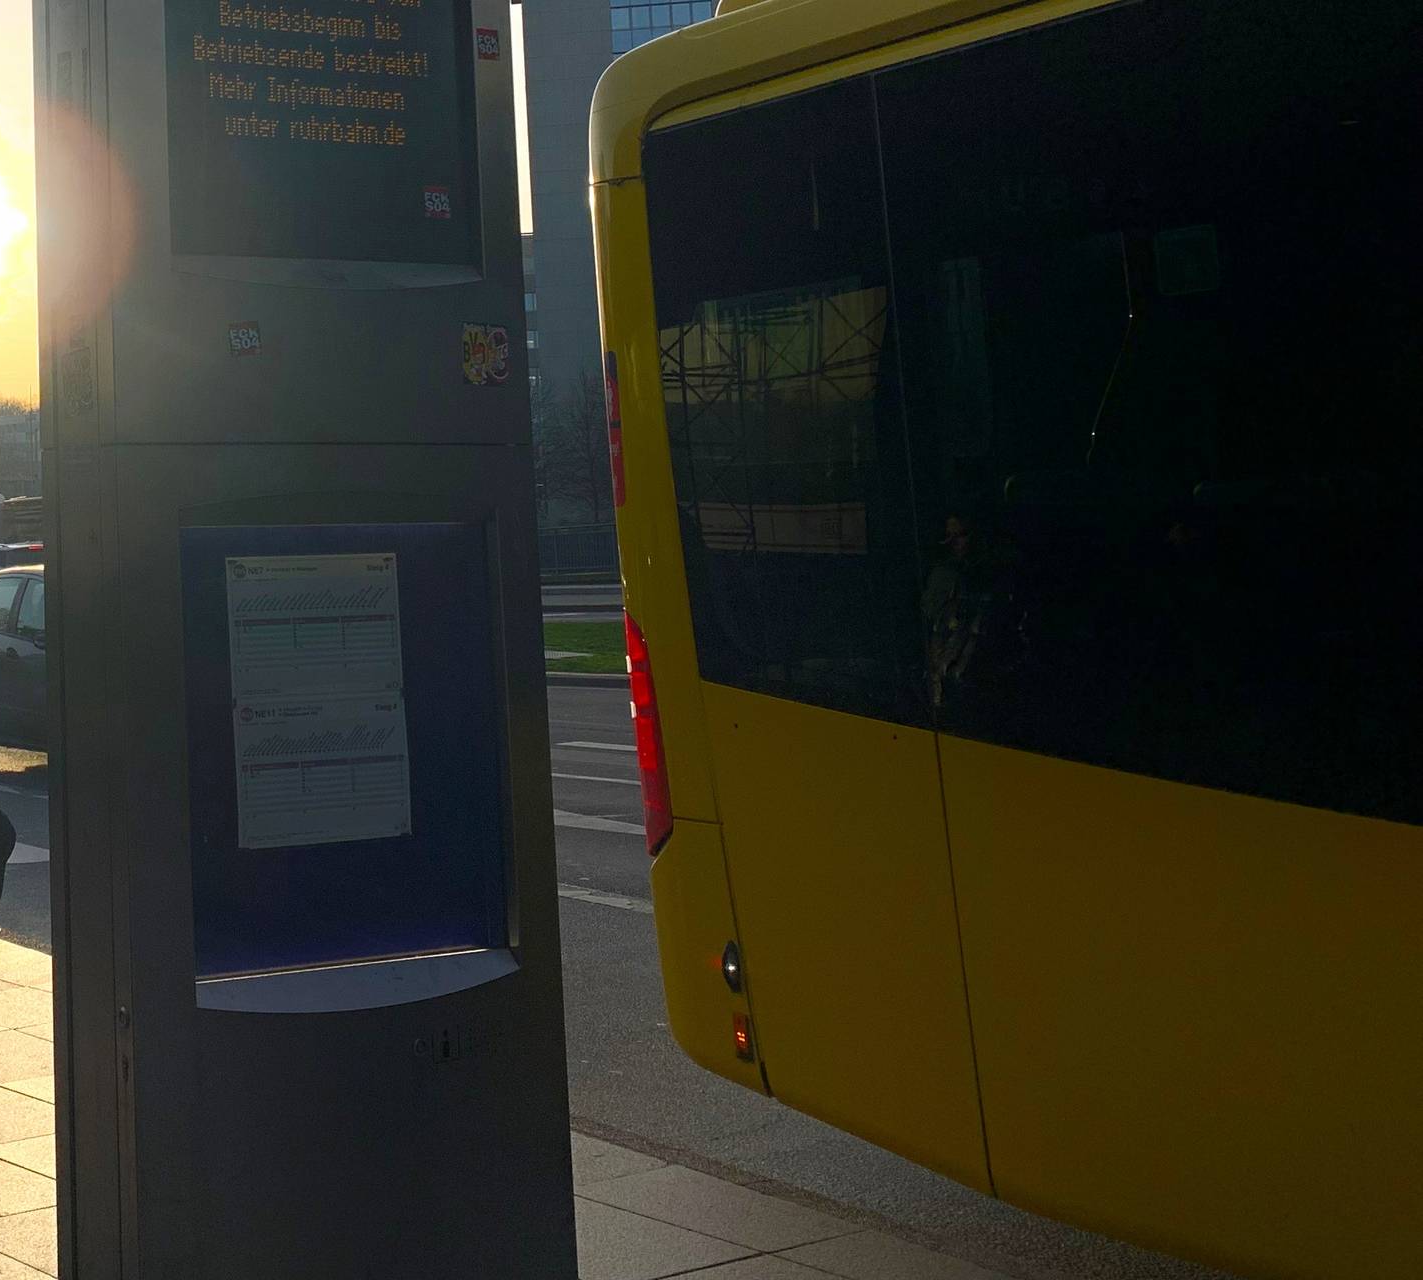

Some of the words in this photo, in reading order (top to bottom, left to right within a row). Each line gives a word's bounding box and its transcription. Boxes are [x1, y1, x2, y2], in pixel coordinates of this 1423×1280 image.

[218, 0, 365, 41] Betriebsbeginn
[373, 14, 402, 40] bis
[478, 35, 498, 44] FCK
[479, 43, 498, 54] S04
[193, 32, 325, 70] Betriebsende
[334, 46, 430, 77] bestreikt!
[209, 72, 257, 100] Mehr
[266, 75, 406, 111] Informationen
[225, 111, 279, 138] unter
[289, 114, 407, 146] ruhrbahn.de
[424, 192, 449, 202] FCK
[424, 201, 451, 212] S04
[230, 328, 258, 339] FCK
[231, 338, 261, 350] S04
